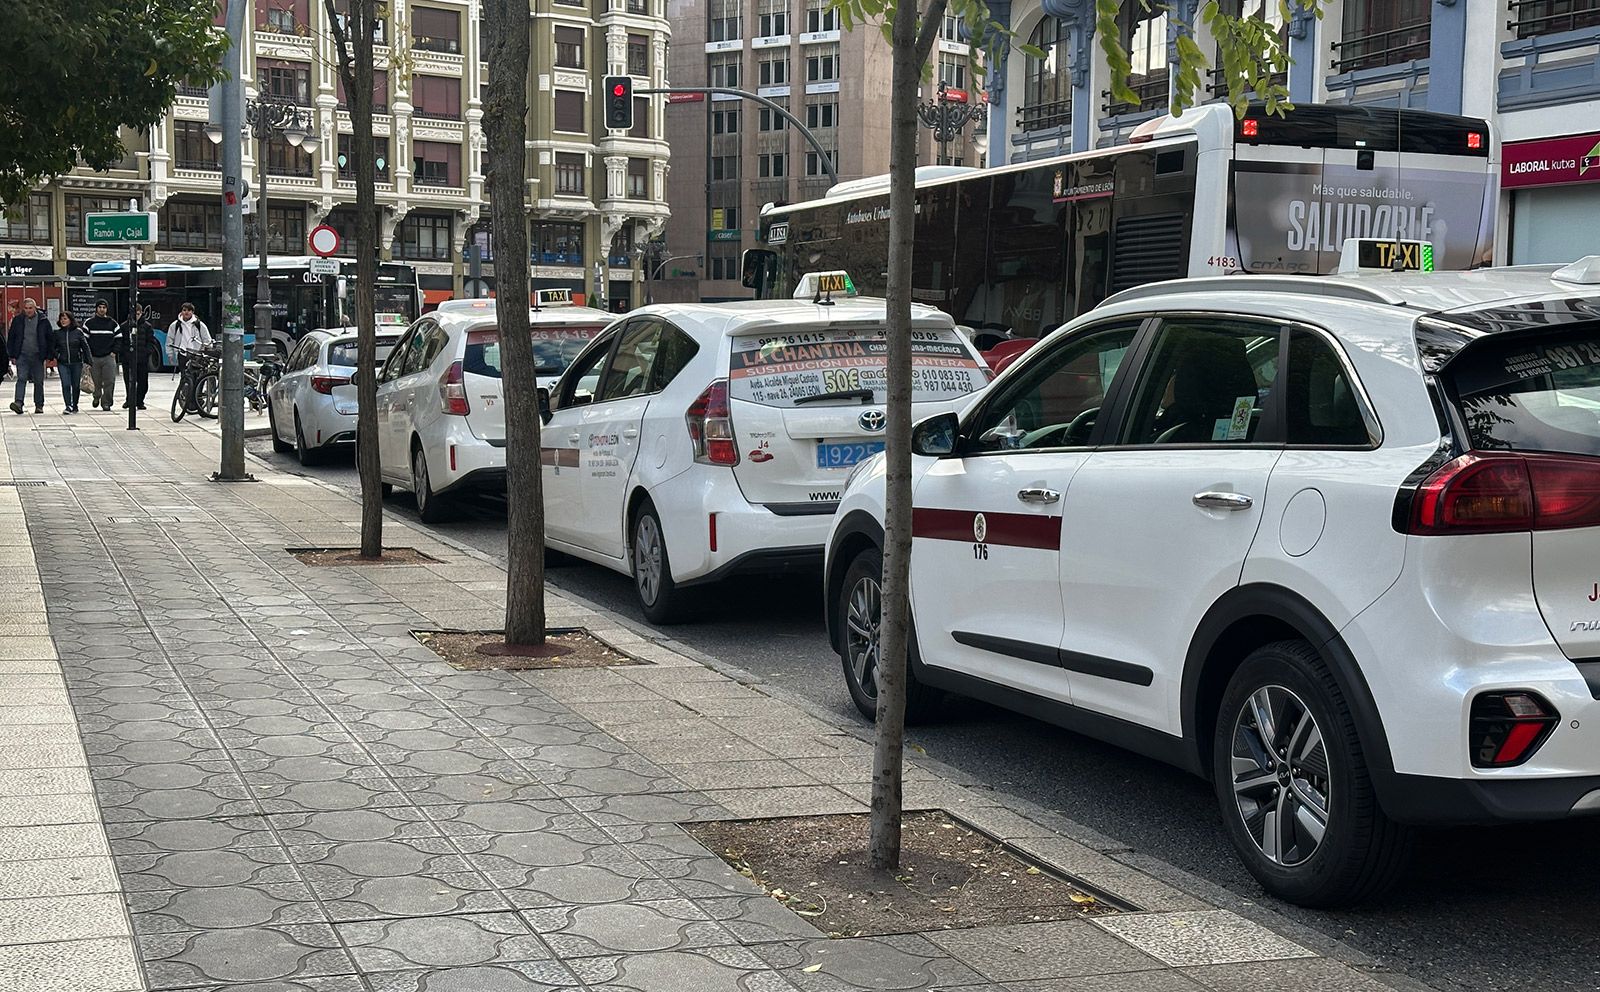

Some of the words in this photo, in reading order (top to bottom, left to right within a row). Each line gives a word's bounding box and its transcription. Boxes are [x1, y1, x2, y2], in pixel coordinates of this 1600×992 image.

[1509, 160, 1550, 174] LABORAL
[1551, 158, 1576, 170] kutxa
[1312, 183, 1335, 195] Más
[1337, 187, 1357, 198] que
[1359, 186, 1415, 200] saludable,
[93, 227, 115, 238] Ramón
[118, 229, 123, 239] y
[126, 226, 143, 239] Cajal
[1207, 255, 1236, 268] 4183
[1376, 242, 1420, 268] TAXI
[15, 265, 33, 274] tiger
[1250, 259, 1311, 271] CITARO
[820, 276, 846, 291] TAXI
[151, 310, 161, 320] Eco
[531, 330, 549, 340] 26
[552, 330, 569, 339] 14
[572, 329, 590, 339] 15
[781, 335, 796, 345] 26
[796, 334, 811, 343] 14
[812, 333, 826, 342] 15
[912, 331, 925, 340] 03
[926, 332, 939, 341] 05
[742, 351, 767, 366] LA
[770, 342, 866, 361] CHANTRIA
[1545, 345, 1585, 369] 987
[745, 359, 841, 377] SUSTITUCIÓN
[844, 357, 885, 367] LUNA
[1504, 358, 1552, 373] PERMANENTE
[1529, 365, 1553, 377] HORAS
[782, 373, 801, 388] Miguel
[800, 372, 819, 383] Castaño
[822, 367, 861, 394] 50€
[860, 370, 876, 379] en
[921, 370, 937, 380] 610
[938, 370, 954, 380] 083
[955, 371, 971, 381] 573
[924, 381, 939, 391] 987
[940, 382, 957, 392] 044
[958, 382, 974, 393] 430
[752, 391, 765, 402] 115
[767, 391, 780, 400] nave
[758, 440, 769, 449] J4
[808, 491, 843, 501] www.
[973, 543, 988, 561] 176
[1588, 582, 1600, 602] J
